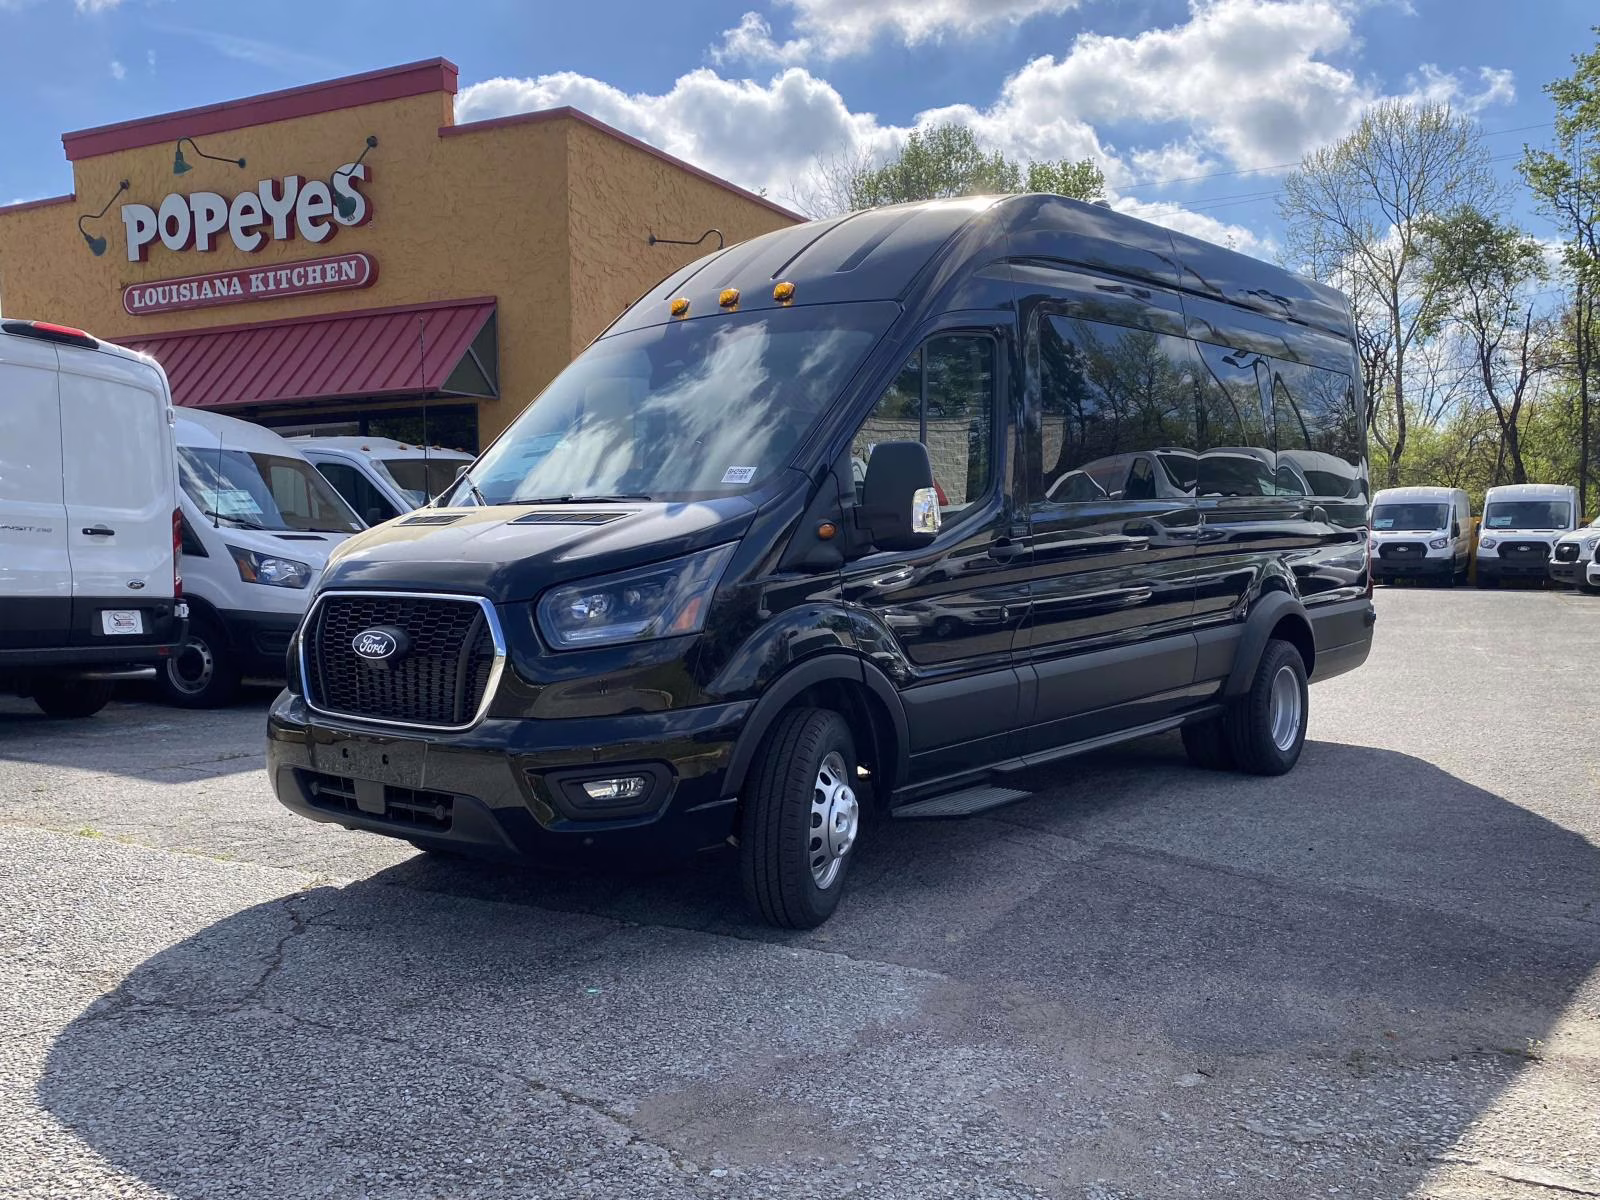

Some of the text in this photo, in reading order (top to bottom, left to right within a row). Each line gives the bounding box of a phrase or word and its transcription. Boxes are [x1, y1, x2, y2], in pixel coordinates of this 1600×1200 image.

[132, 260, 358, 308] LOUISIANA KITCHEN
[360, 634, 388, 654] Ford
